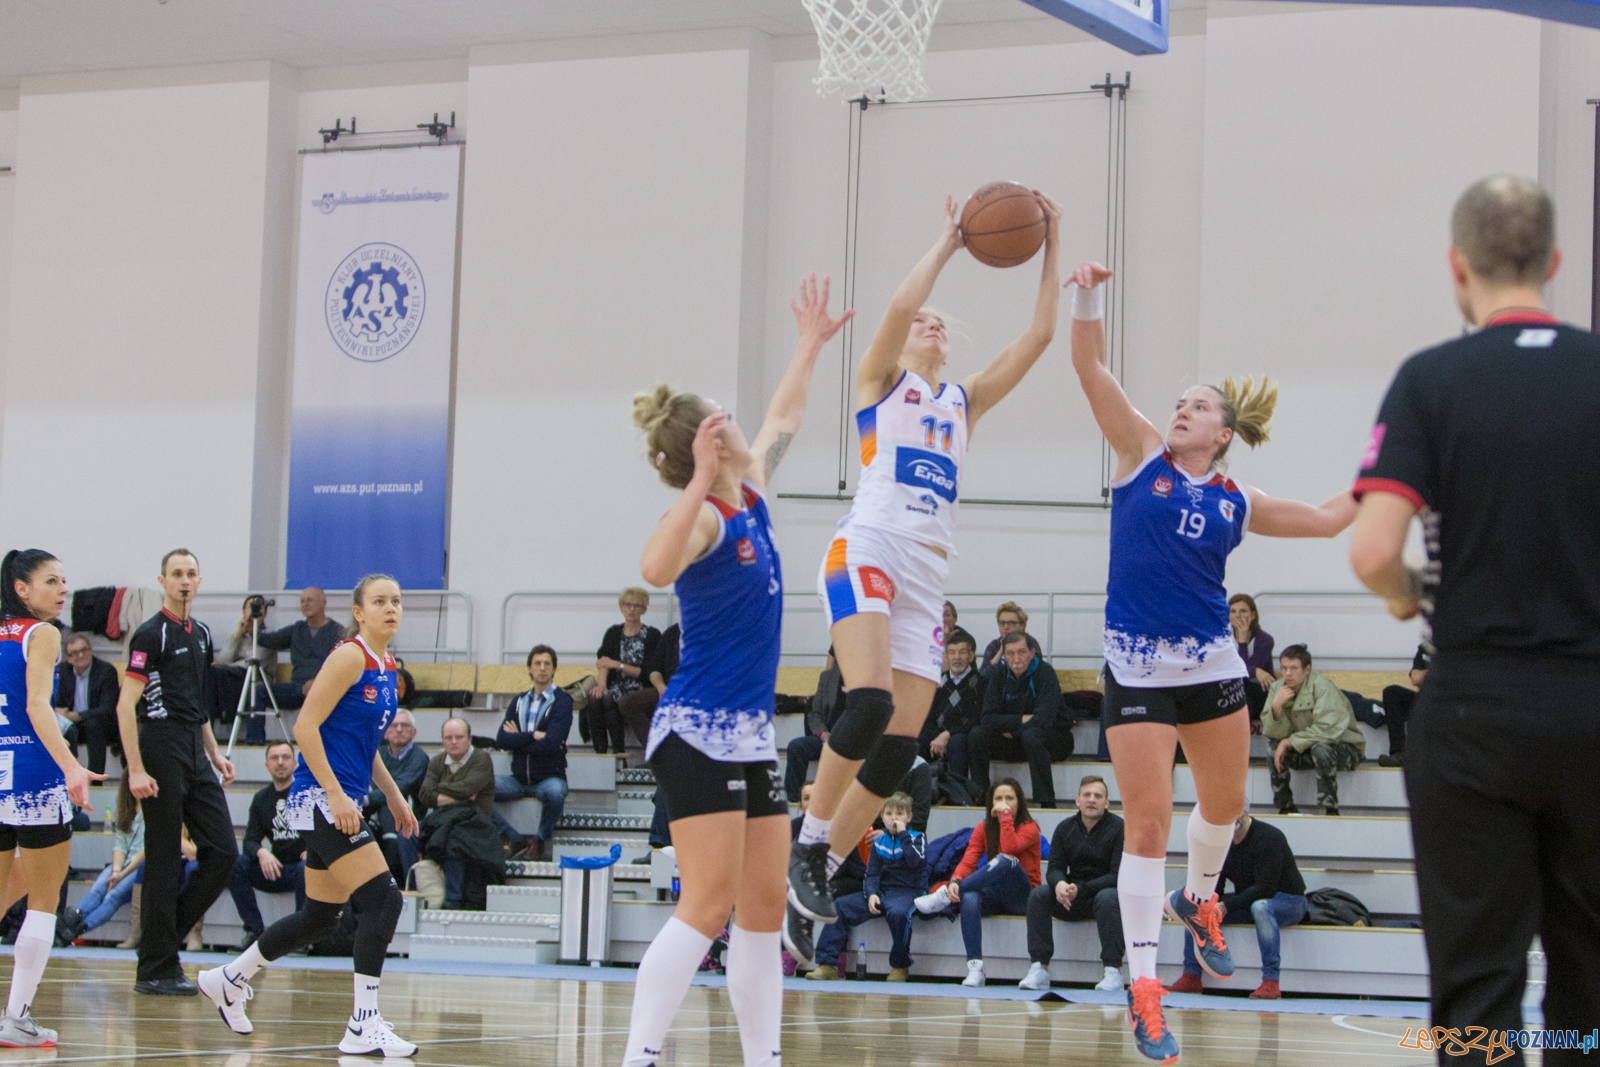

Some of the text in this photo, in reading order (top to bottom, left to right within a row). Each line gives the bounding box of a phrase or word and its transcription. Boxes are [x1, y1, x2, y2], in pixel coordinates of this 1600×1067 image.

[337, 248, 417, 284] KLUB UCZELNIANY
[330, 298, 373, 356] POLITECHNIKI
[921, 415, 954, 453] 11
[313, 480, 423, 496] www.azs.put.poznan.pl
[914, 464, 955, 491] Enea
[1176, 508, 1206, 539] 19
[378, 710, 391, 730] 5
